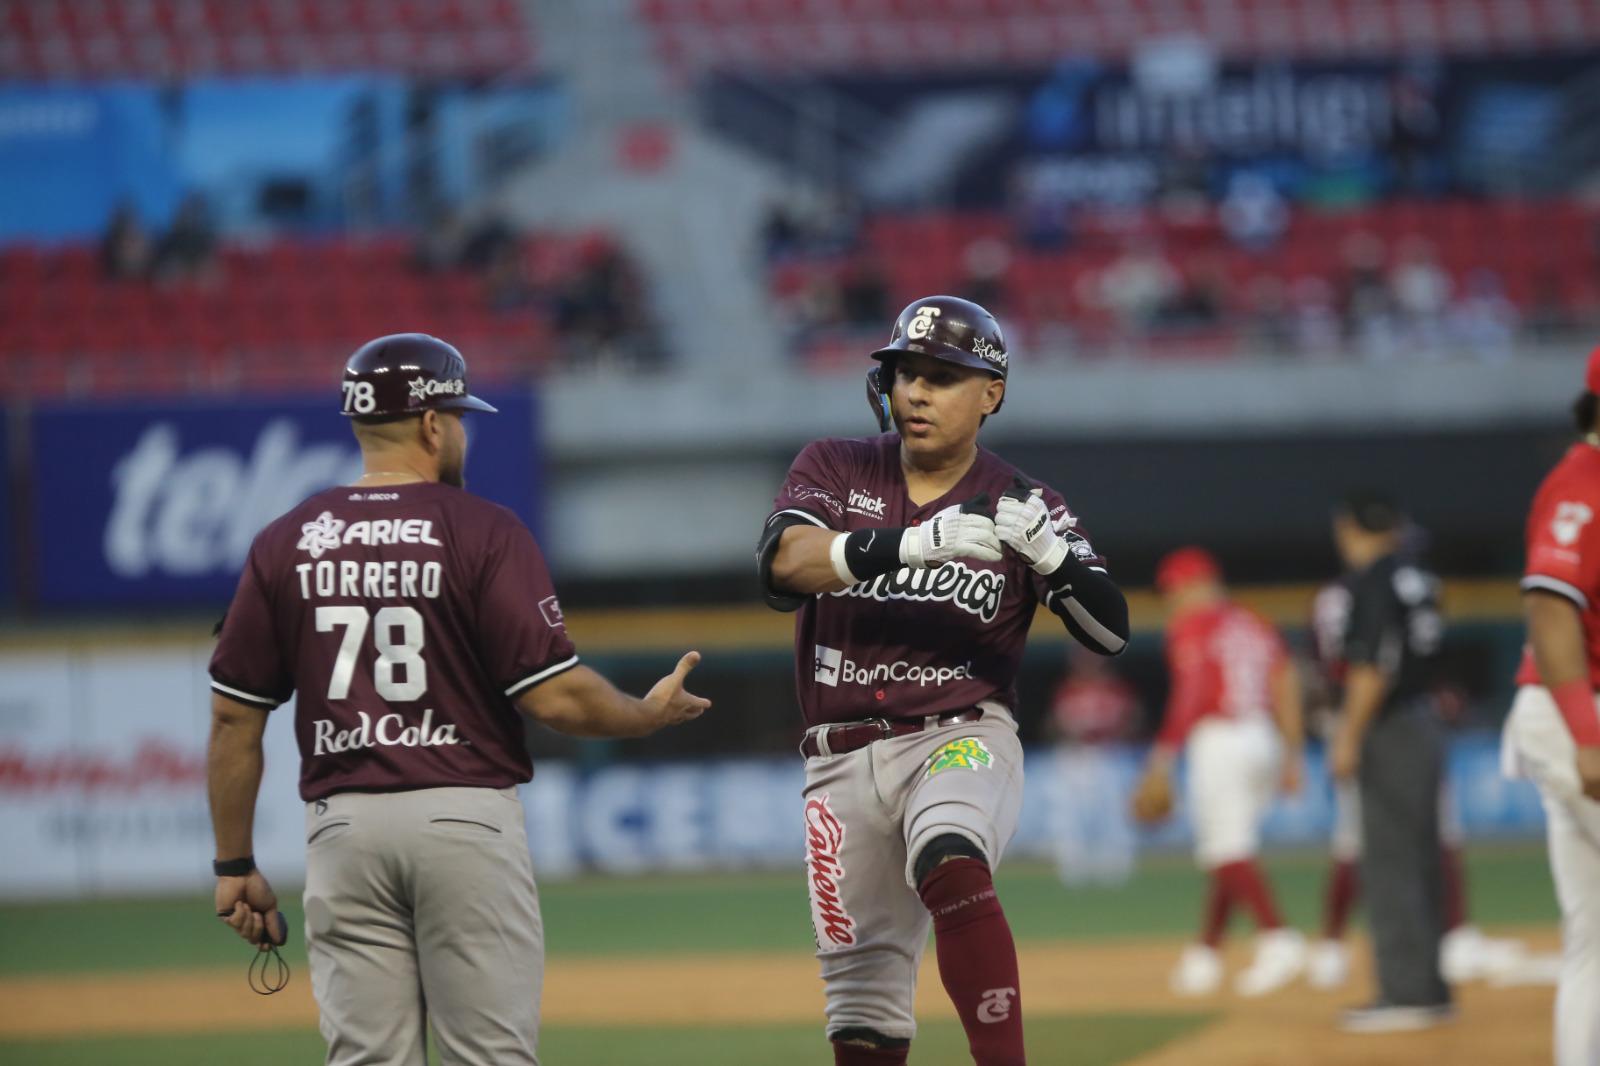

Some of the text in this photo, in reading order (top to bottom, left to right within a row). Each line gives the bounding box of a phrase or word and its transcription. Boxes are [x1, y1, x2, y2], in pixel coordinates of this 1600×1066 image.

[341, 380, 376, 414] 78
[342, 518, 444, 547] ARIEL
[296, 560, 442, 600] TORRERO
[315, 606, 427, 702] 78
[842, 659, 974, 687] BanCoppel
[806, 795, 853, 945] Caliente
